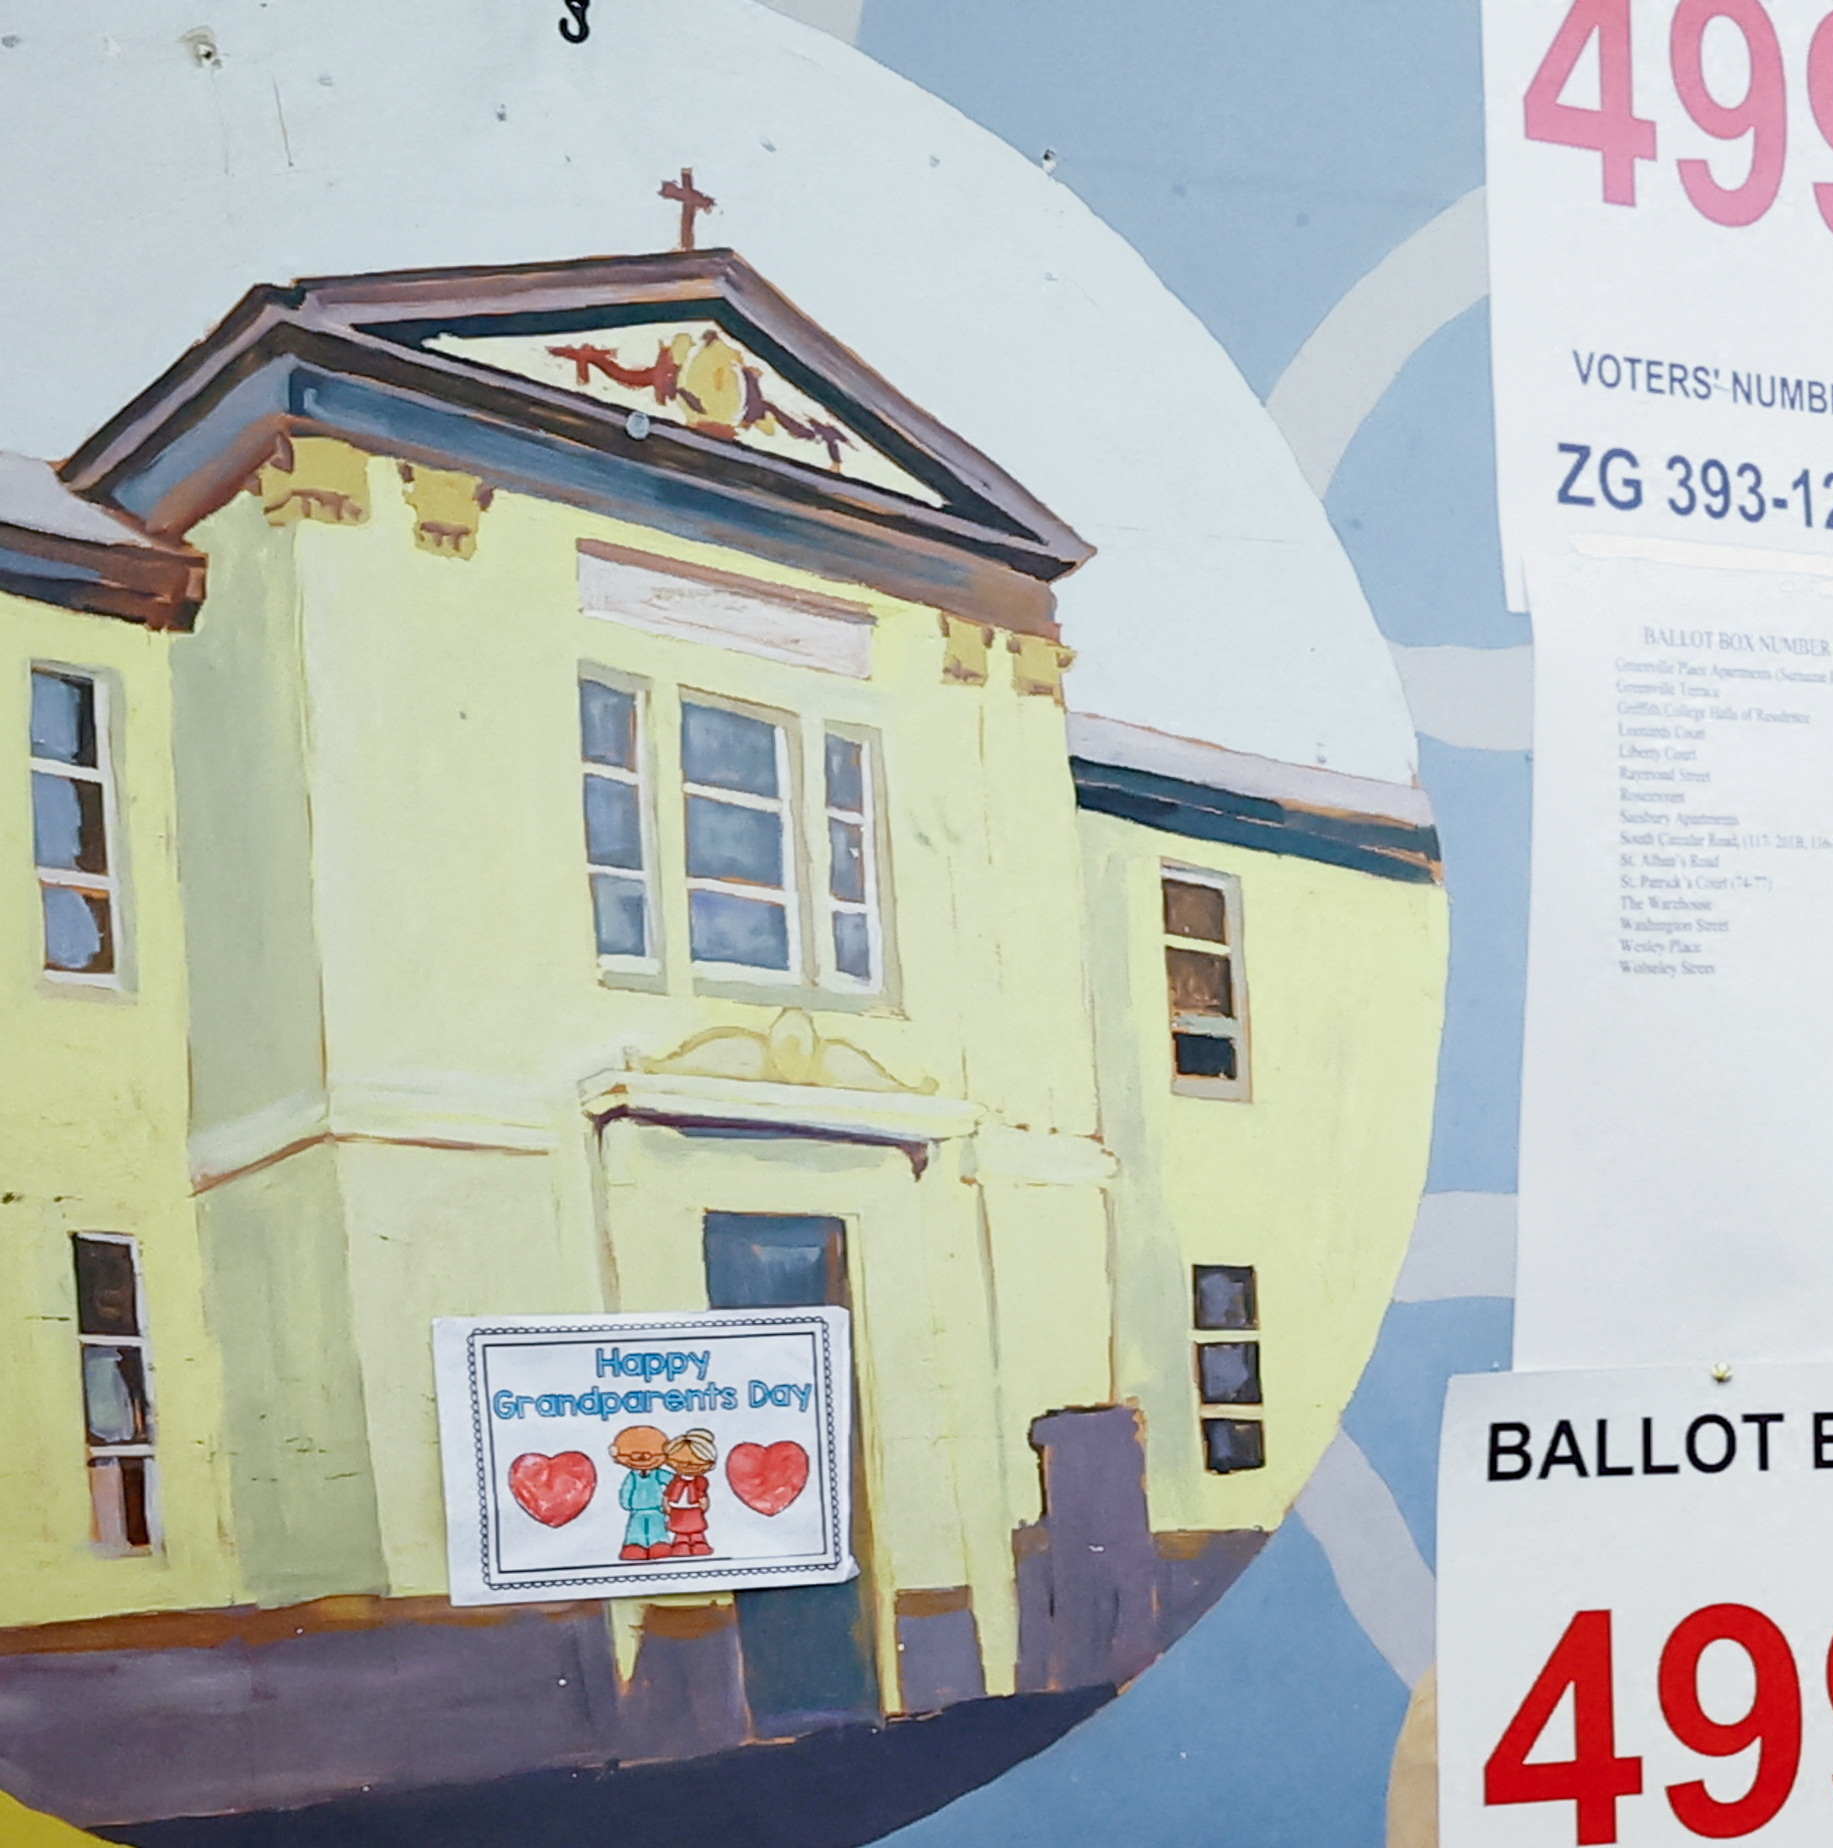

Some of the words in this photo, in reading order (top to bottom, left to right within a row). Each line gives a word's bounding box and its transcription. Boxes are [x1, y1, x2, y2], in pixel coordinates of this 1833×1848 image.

[1573, 349, 1722, 401] VOTERS'
[1557, 442, 1643, 511] ZG
[1643, 626, 1715, 650] BALLOT
[1719, 631, 1755, 652] BOX
[1759, 636, 1831, 656] NUMBER
[596, 1347, 711, 1382] Happy
[493, 1384, 738, 1421] Grandparents
[748, 1379, 813, 1414] Day
[1486, 1411, 1785, 1482] BALLOT
